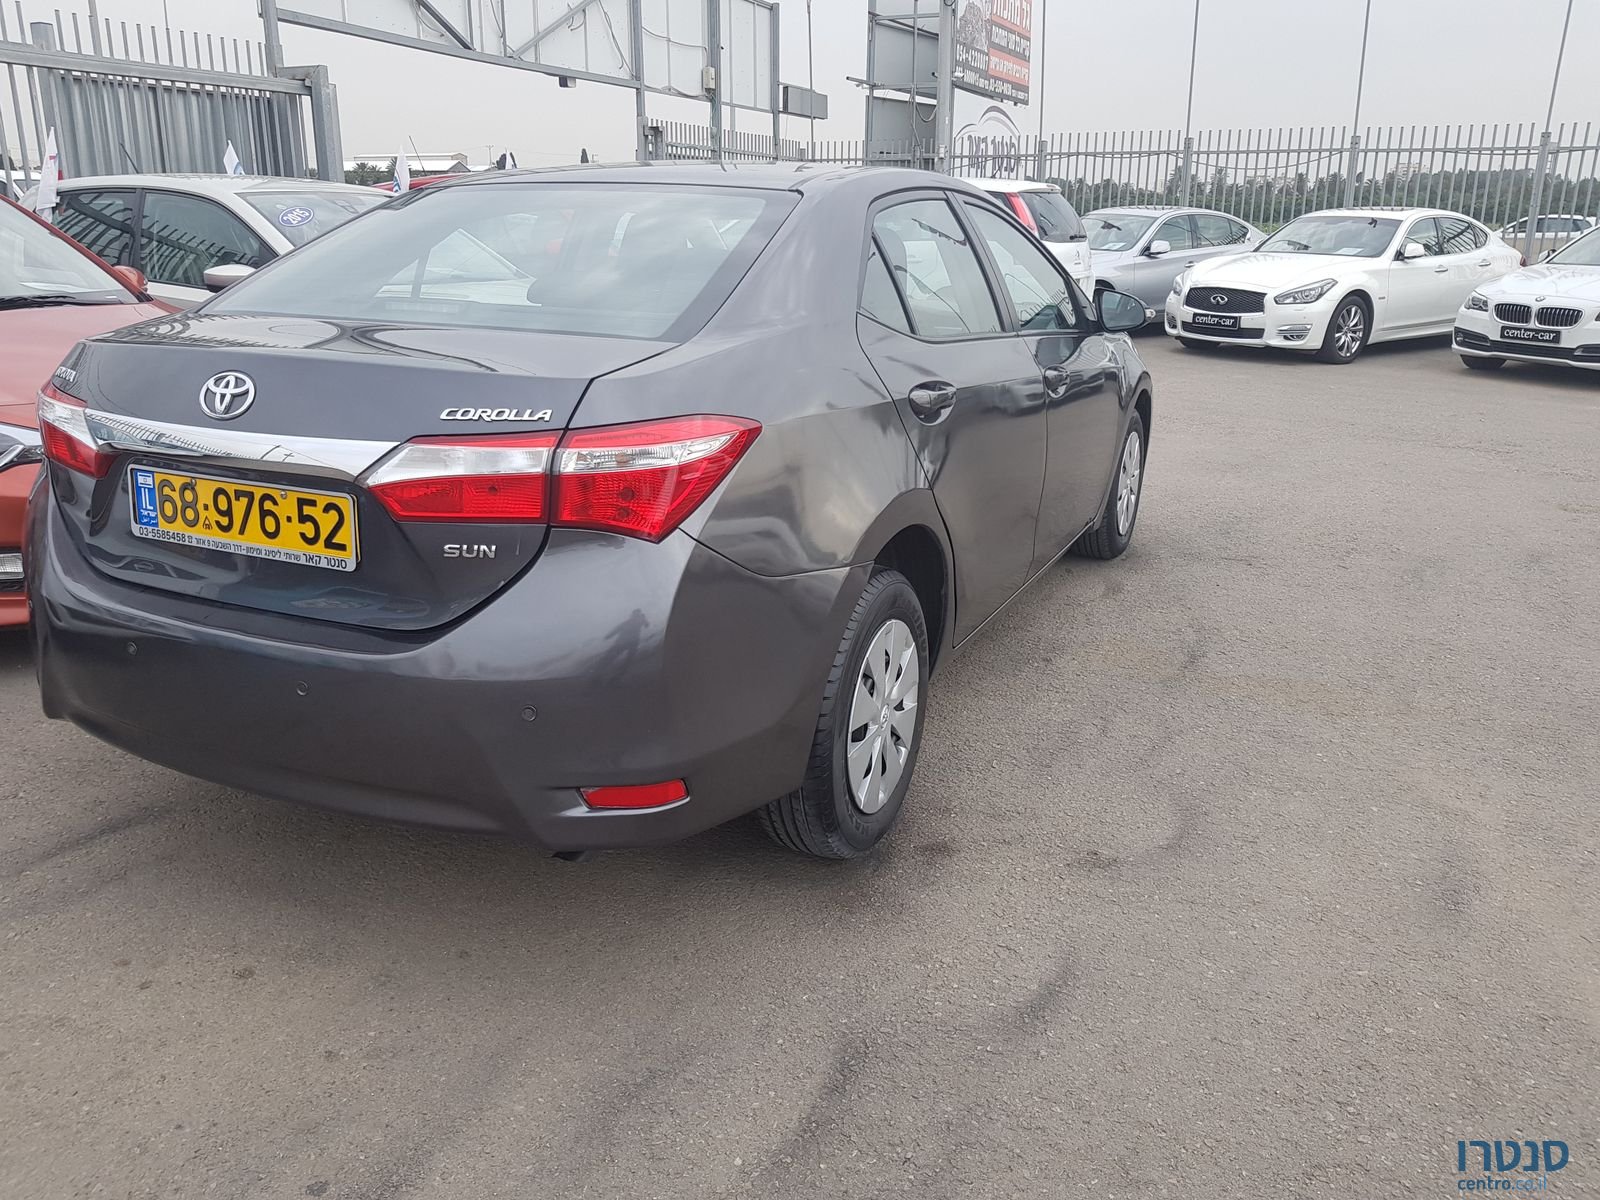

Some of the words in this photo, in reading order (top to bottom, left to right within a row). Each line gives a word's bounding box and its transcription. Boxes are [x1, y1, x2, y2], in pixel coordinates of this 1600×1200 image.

[283, 208, 310, 224] 2015
[1194, 314, 1236, 328] center-car
[1503, 328, 1558, 342] center-car
[440, 407, 553, 422] COROLLA
[141, 487, 154, 510] IL
[139, 526, 186, 543] 03-5585458
[211, 540, 232, 551] השבעה
[443, 543, 496, 559] SUN
[263, 547, 282, 559] ליסינג
[302, 552, 322, 566] קאר
[323, 556, 348, 570] סנטר
